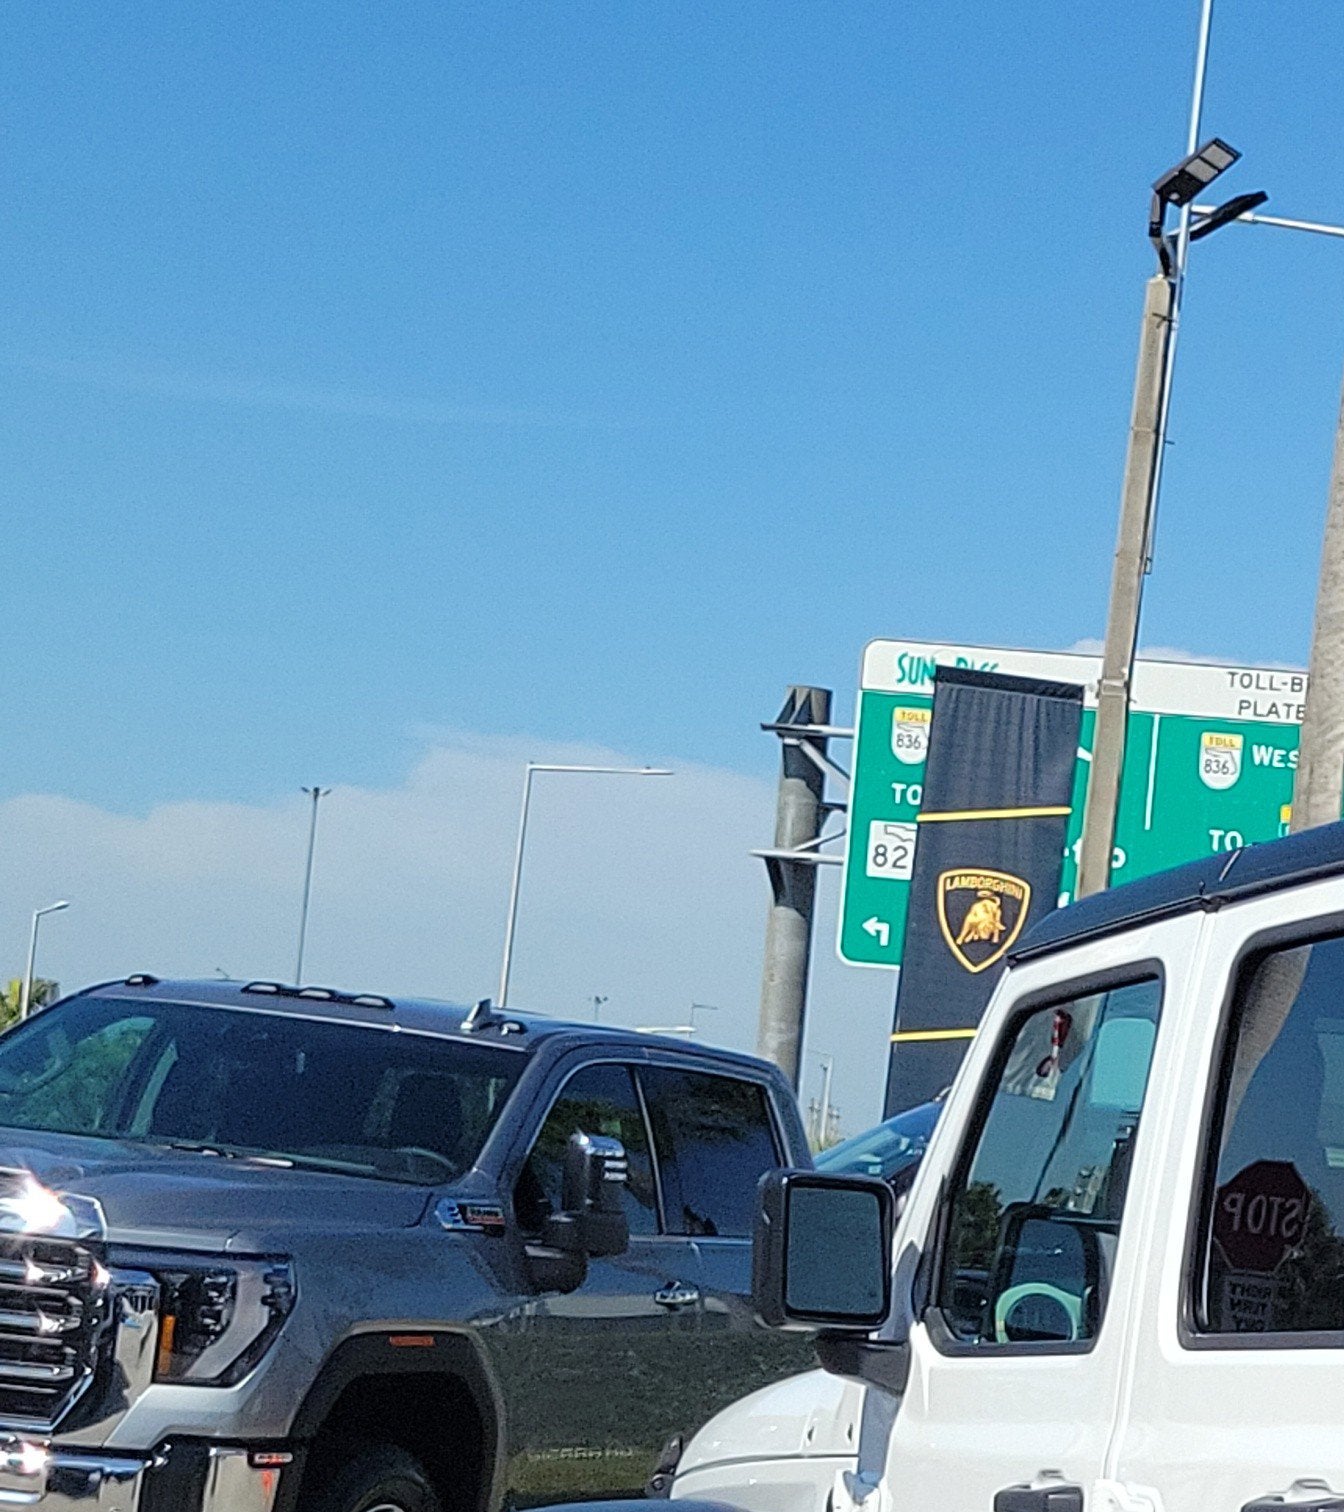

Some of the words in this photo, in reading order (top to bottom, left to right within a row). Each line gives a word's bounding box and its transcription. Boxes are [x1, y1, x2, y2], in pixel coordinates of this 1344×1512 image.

[1228, 671, 1304, 693] TOLL-B
[896, 733, 922, 750] 836
[1208, 736, 1236, 748] TOLL
[1203, 758, 1230, 776] 836
[1252, 744, 1300, 769] WES
[891, 782, 923, 806] TO
[1209, 829, 1243, 851] TO
[945, 875, 1023, 900] LAMBORGHINI
